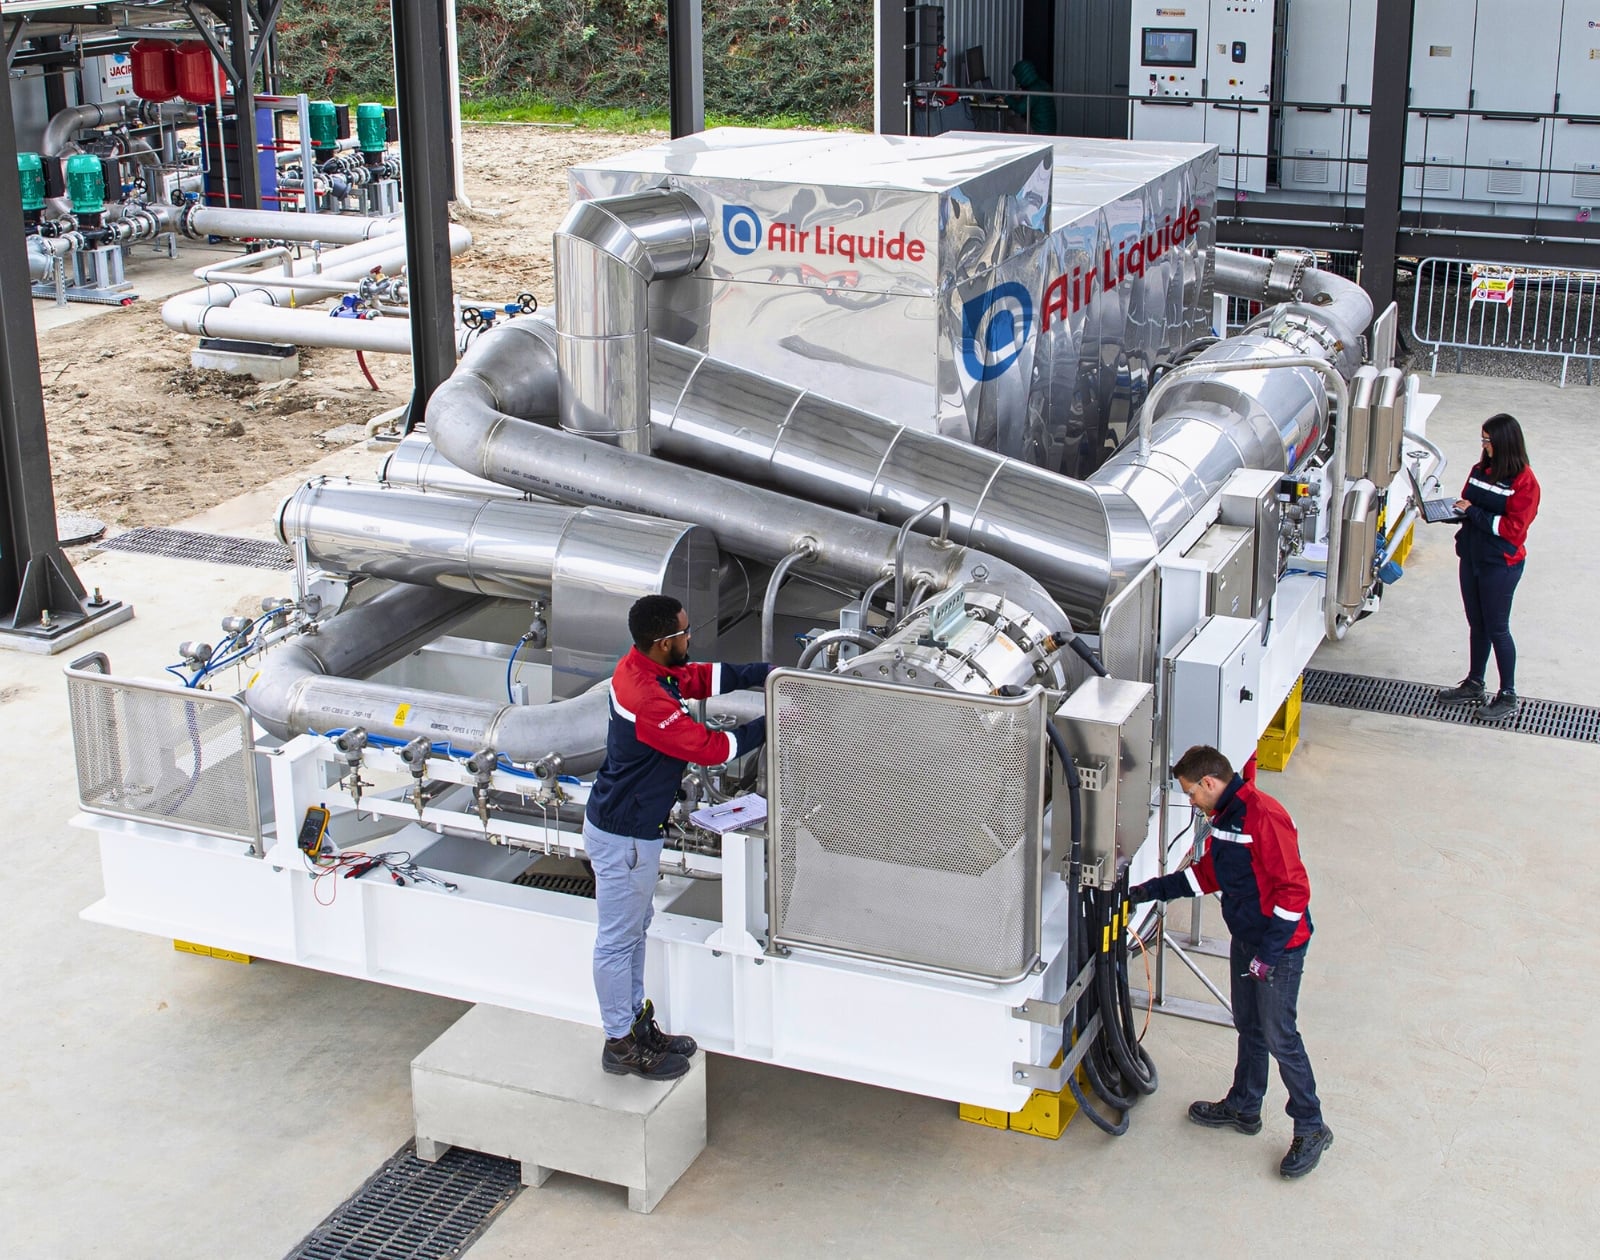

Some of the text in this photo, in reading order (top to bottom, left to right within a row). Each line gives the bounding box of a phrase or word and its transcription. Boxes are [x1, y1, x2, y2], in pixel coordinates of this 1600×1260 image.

[768, 222, 926, 264] Air Liquide
[1042, 206, 1200, 334] Air Liquide
